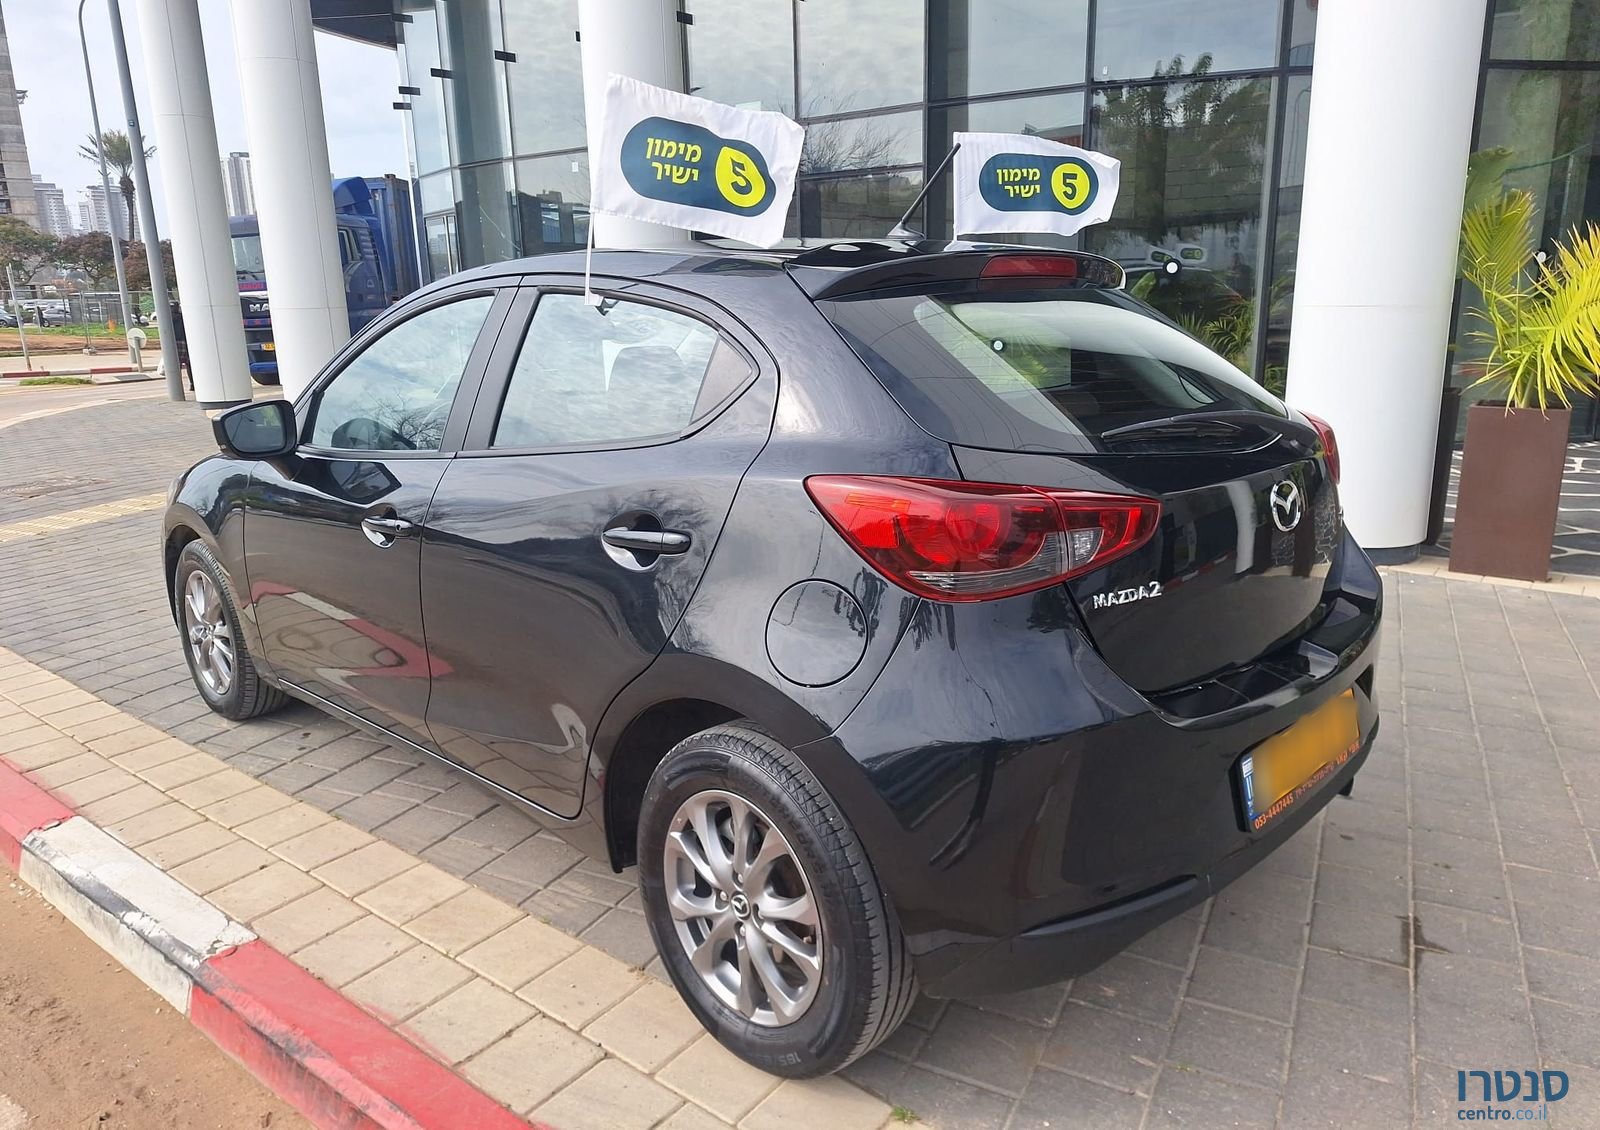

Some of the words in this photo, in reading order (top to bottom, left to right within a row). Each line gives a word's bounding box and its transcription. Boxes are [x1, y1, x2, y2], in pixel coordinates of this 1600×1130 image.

[646, 137, 702, 163] מימון
[651, 161, 699, 184] ישיר
[730, 155, 753, 196] 5
[996, 168, 1041, 185] מימון
[1004, 184, 1041, 198] ישיר
[1062, 172, 1078, 201] 5
[249, 303, 270, 312] MA
[1092, 581, 1162, 609] MAZDA2
